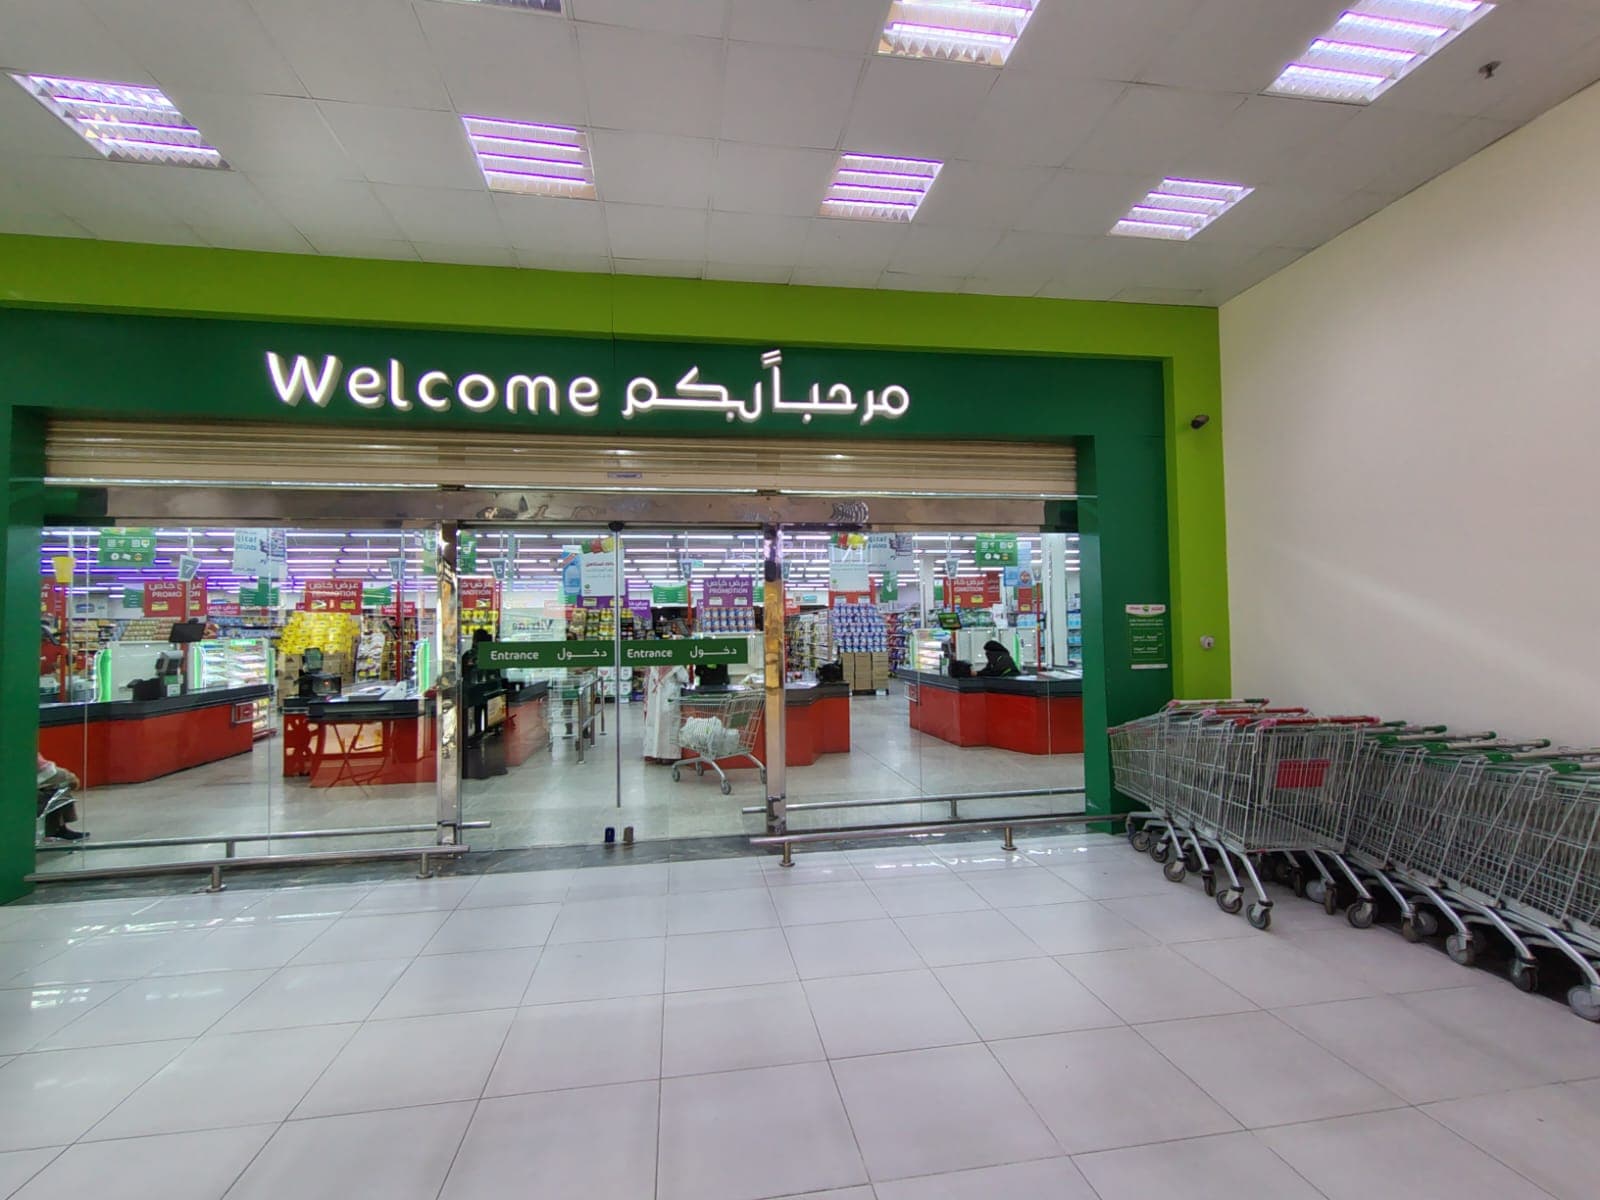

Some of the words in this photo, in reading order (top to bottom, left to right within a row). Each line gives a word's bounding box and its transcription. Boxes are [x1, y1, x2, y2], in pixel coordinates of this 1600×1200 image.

[265, 350, 601, 416] Welcome
[184, 565, 194, 575] 7
[496, 564, 503, 574] 5
[335, 582, 358, 590] عرض
[728, 579, 750, 587] عرض
[151, 590, 201, 598] PROMOON
[490, 649, 539, 661] Entrance
[626, 648, 673, 660] Entrance
